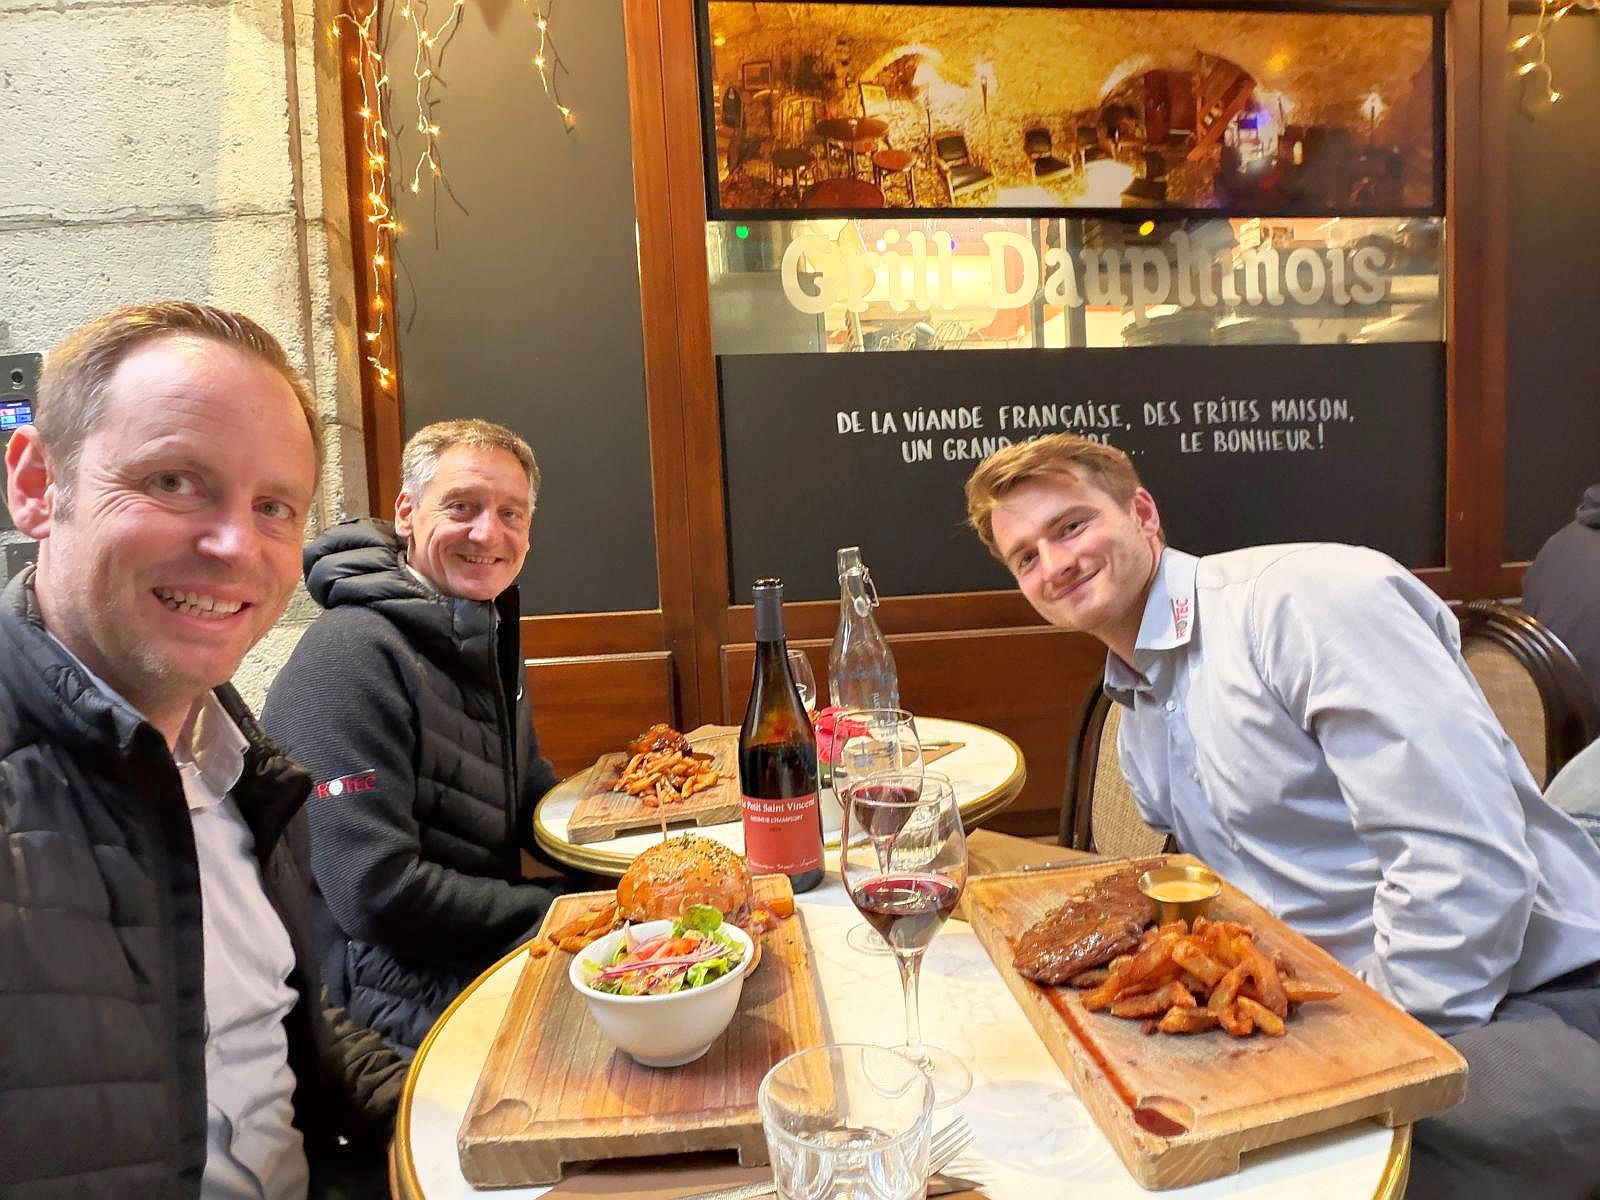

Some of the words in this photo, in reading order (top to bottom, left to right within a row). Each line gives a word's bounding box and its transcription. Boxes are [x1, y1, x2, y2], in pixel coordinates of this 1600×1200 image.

[781, 230, 957, 314] Grill
[982, 228, 1388, 328] Dauphinois
[836, 411, 866, 434] DE
[871, 411, 898, 435] LA
[902, 406, 984, 433] VIANDE
[999, 400, 1132, 432] FRANÇAISE,
[1143, 401, 1181, 427] DES
[1193, 396, 1260, 424] FRITES
[1271, 398, 1354, 423] MAISON,
[901, 437, 933, 464] UN
[1180, 432, 1204, 453] LE
[763, 802, 784, 813] Saint
